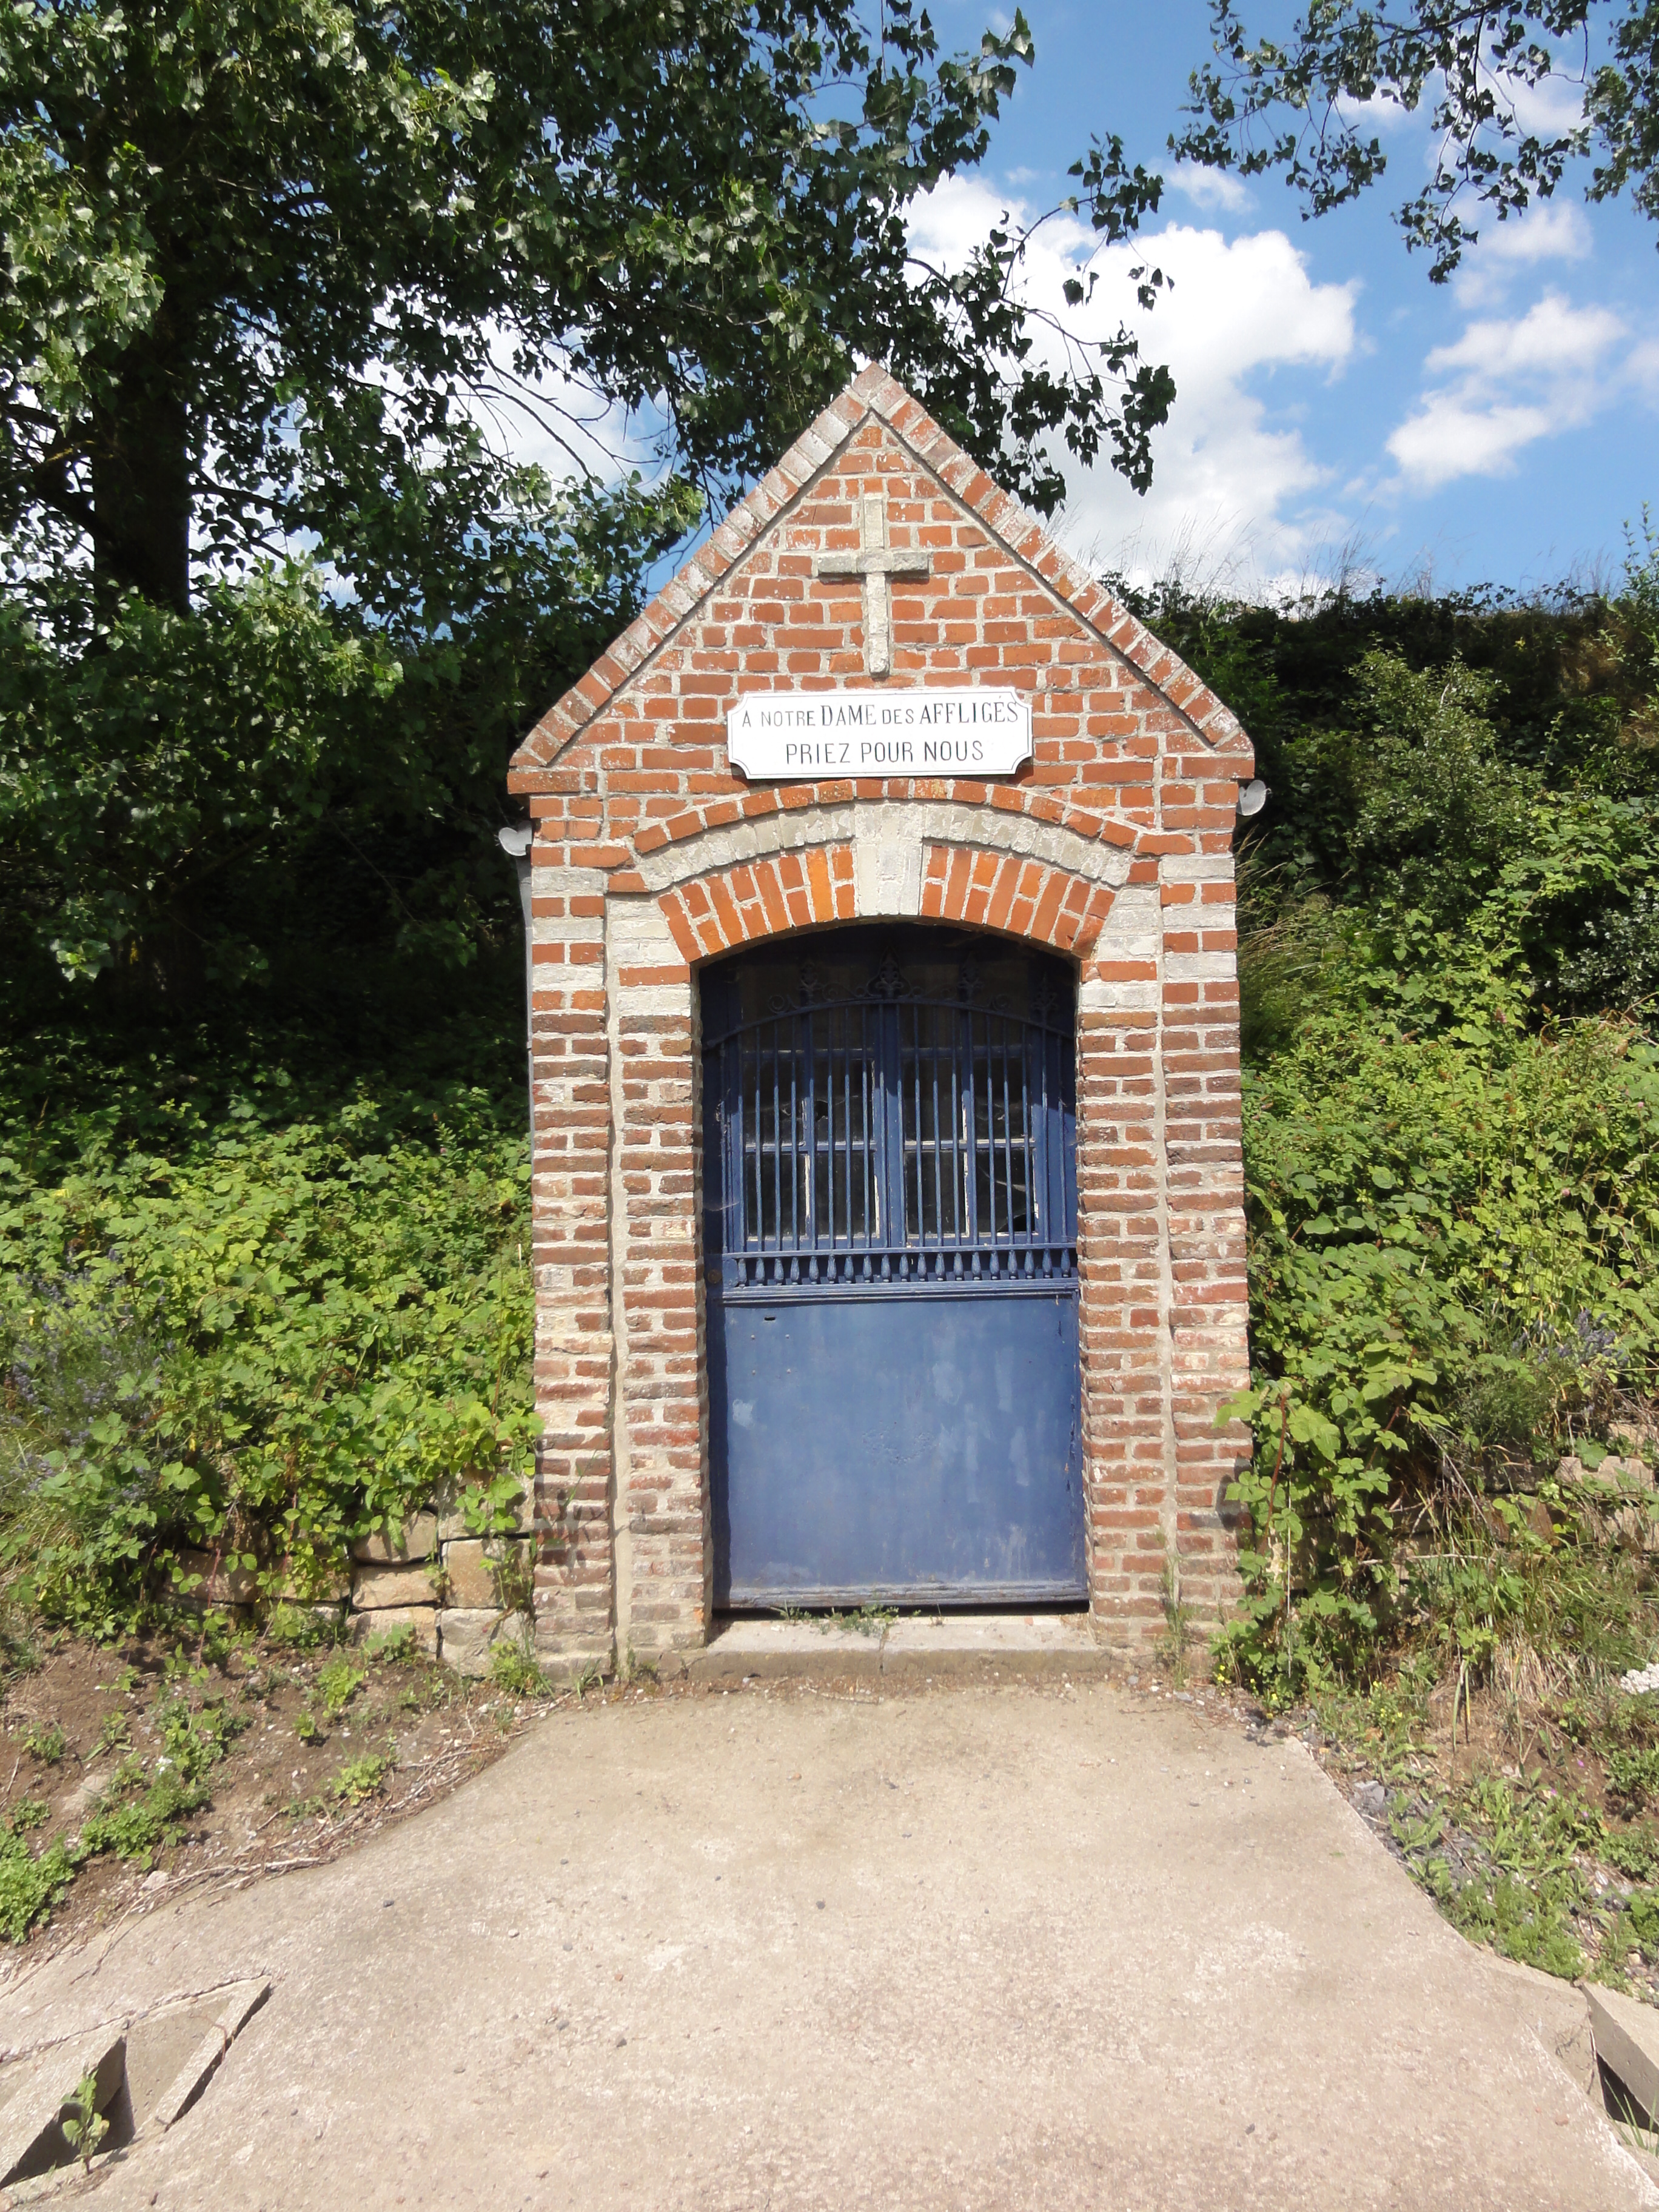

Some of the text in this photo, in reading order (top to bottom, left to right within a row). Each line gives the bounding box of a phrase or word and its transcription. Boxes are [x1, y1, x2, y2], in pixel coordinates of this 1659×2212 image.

[742, 695, 1019, 728] A NOTRE DAME DES AFFLIGÉS
[786, 740, 984, 765] PRIEZ POUR NOUS
